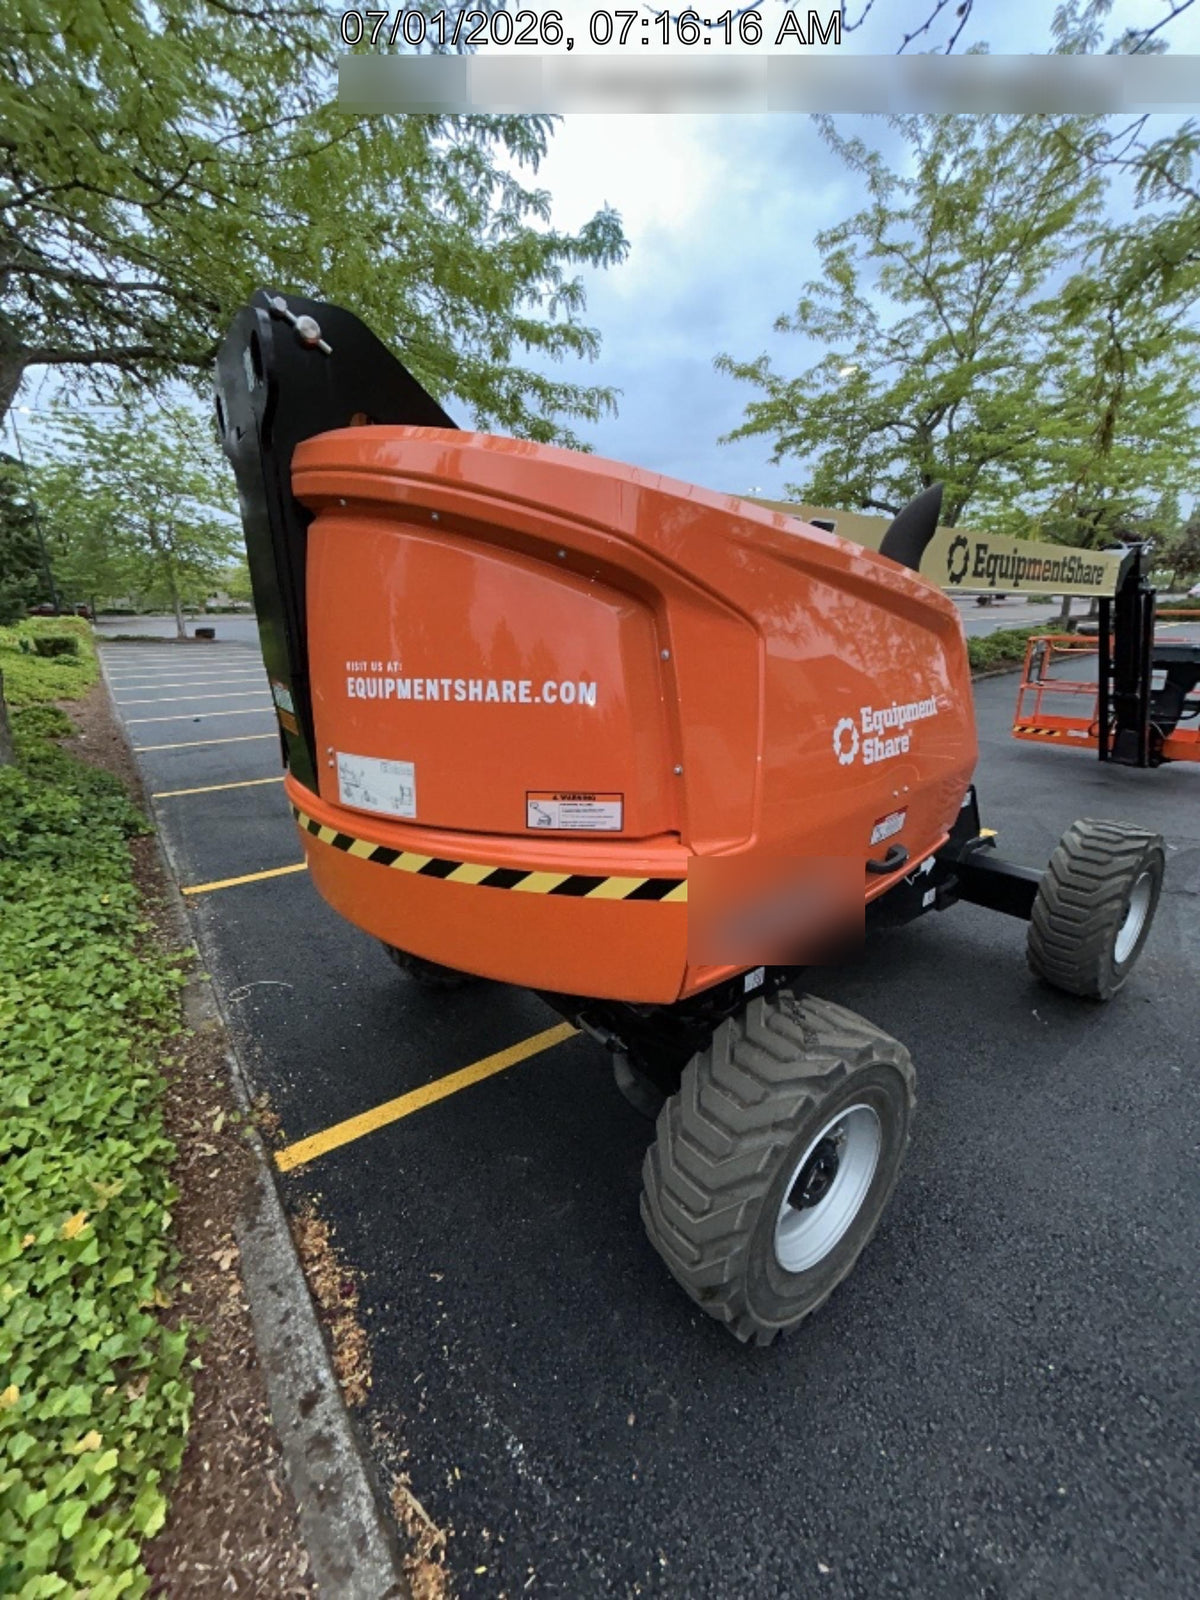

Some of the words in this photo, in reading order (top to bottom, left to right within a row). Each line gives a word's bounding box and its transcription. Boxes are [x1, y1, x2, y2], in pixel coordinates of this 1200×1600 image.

[972, 543, 1104, 587] EquipmentShare
[371, 661, 383, 672] US
[347, 676, 597, 705] EQUIPMENTSHARE.COM
[860, 695, 938, 735] Equipment
[862, 734, 910, 766] Share
